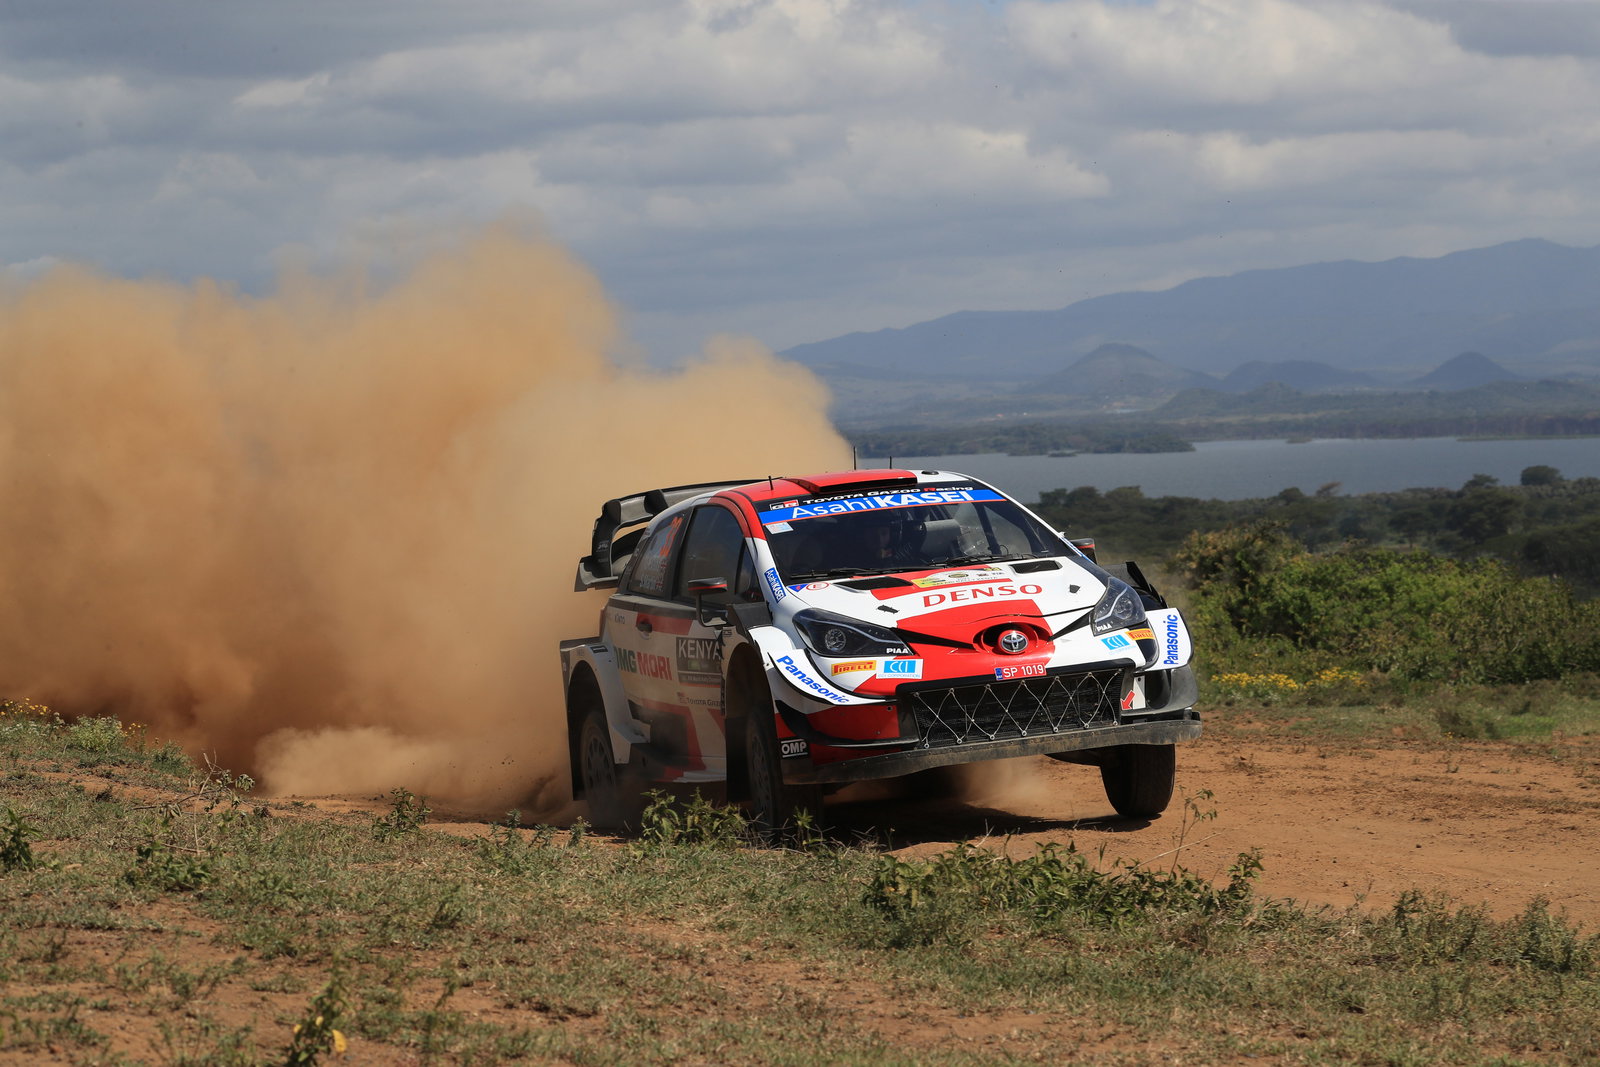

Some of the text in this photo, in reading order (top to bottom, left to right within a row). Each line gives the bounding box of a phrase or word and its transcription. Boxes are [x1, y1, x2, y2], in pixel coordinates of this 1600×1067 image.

[803, 493, 863, 504] TOYOTA
[923, 584, 1042, 607] DENSO
[1096, 623, 1113, 632] PIAA
[1163, 614, 1179, 665] Panasonic
[678, 639, 721, 660] KENYA
[637, 652, 673, 680] MORI
[833, 661, 874, 674] PIRELLI
[1003, 667, 1018, 678] SP
[1021, 664, 1044, 676] 1019
[776, 655, 849, 703] Panasonic
[781, 741, 807, 755] OMP
